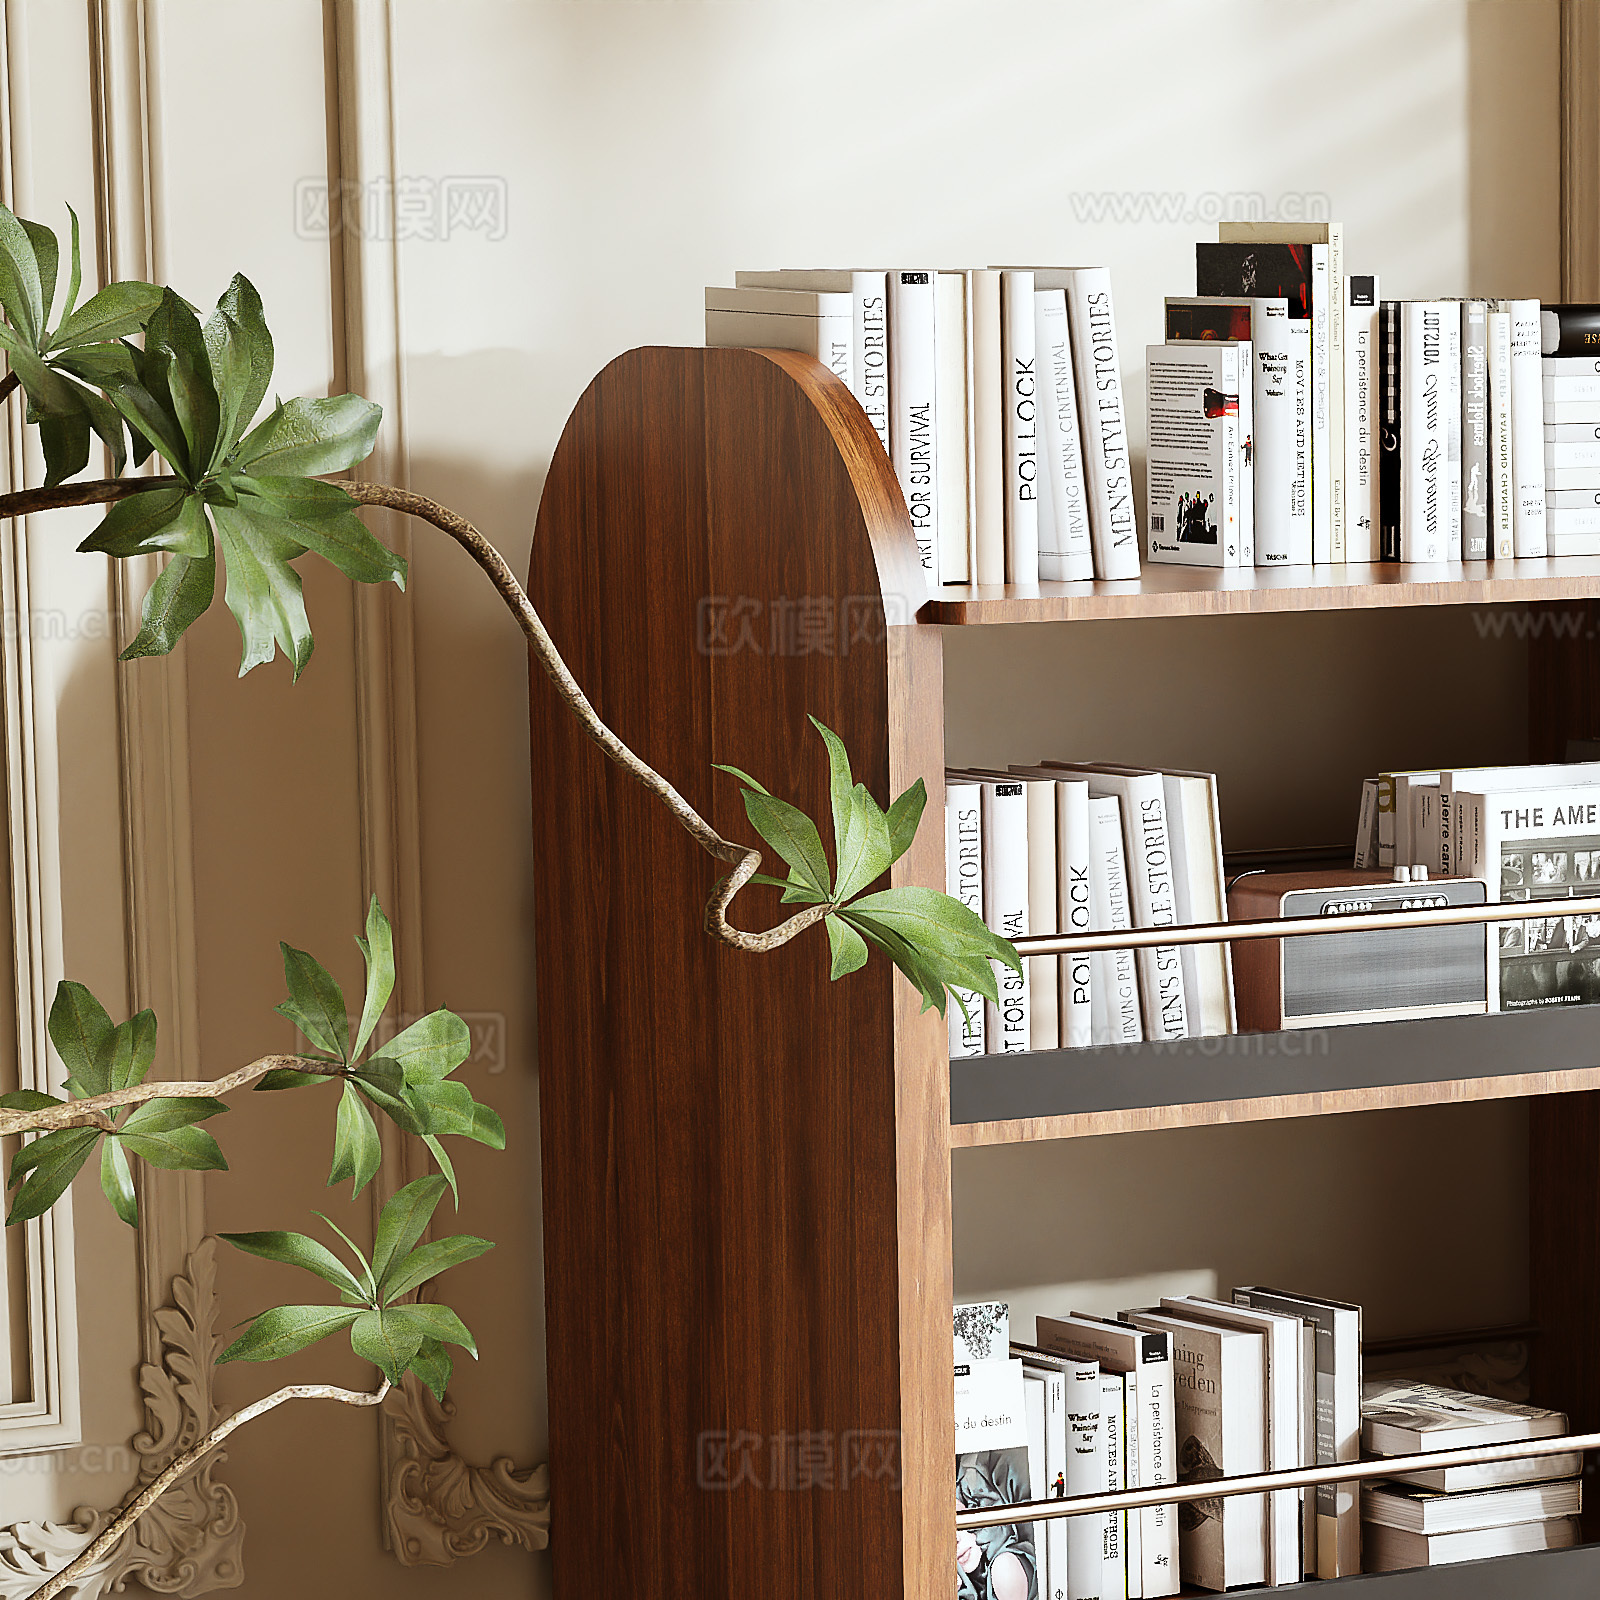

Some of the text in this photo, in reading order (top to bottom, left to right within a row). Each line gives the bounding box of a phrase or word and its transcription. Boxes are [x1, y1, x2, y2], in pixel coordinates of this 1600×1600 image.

[863, 297, 885, 397] STORIES
[1317, 328, 1325, 363] Style
[1051, 341, 1074, 433] CENTENNIAL
[1088, 292, 1133, 548] MEN'S STYLE STORIES
[1316, 380, 1325, 429] Design
[1356, 331, 1370, 486] La persistance du destin
[1015, 358, 1037, 501] POLLOCK
[1296, 360, 1305, 517] MOVIES AND METHODS
[909, 402, 931, 528] FOR SURVIVAL
[1065, 485, 1084, 539] IRVING
[1140, 798, 1170, 894] STORIES
[1440, 794, 1451, 838] pierre
[1500, 808, 1544, 830] THE
[1003, 996, 1024, 1032] FOR
[1118, 985, 1136, 1040] IRVING
[963, 1413, 1013, 1431] du destin
[1106, 1415, 1116, 1467] MOVIES
[1148, 1384, 1162, 1469] La persistance
